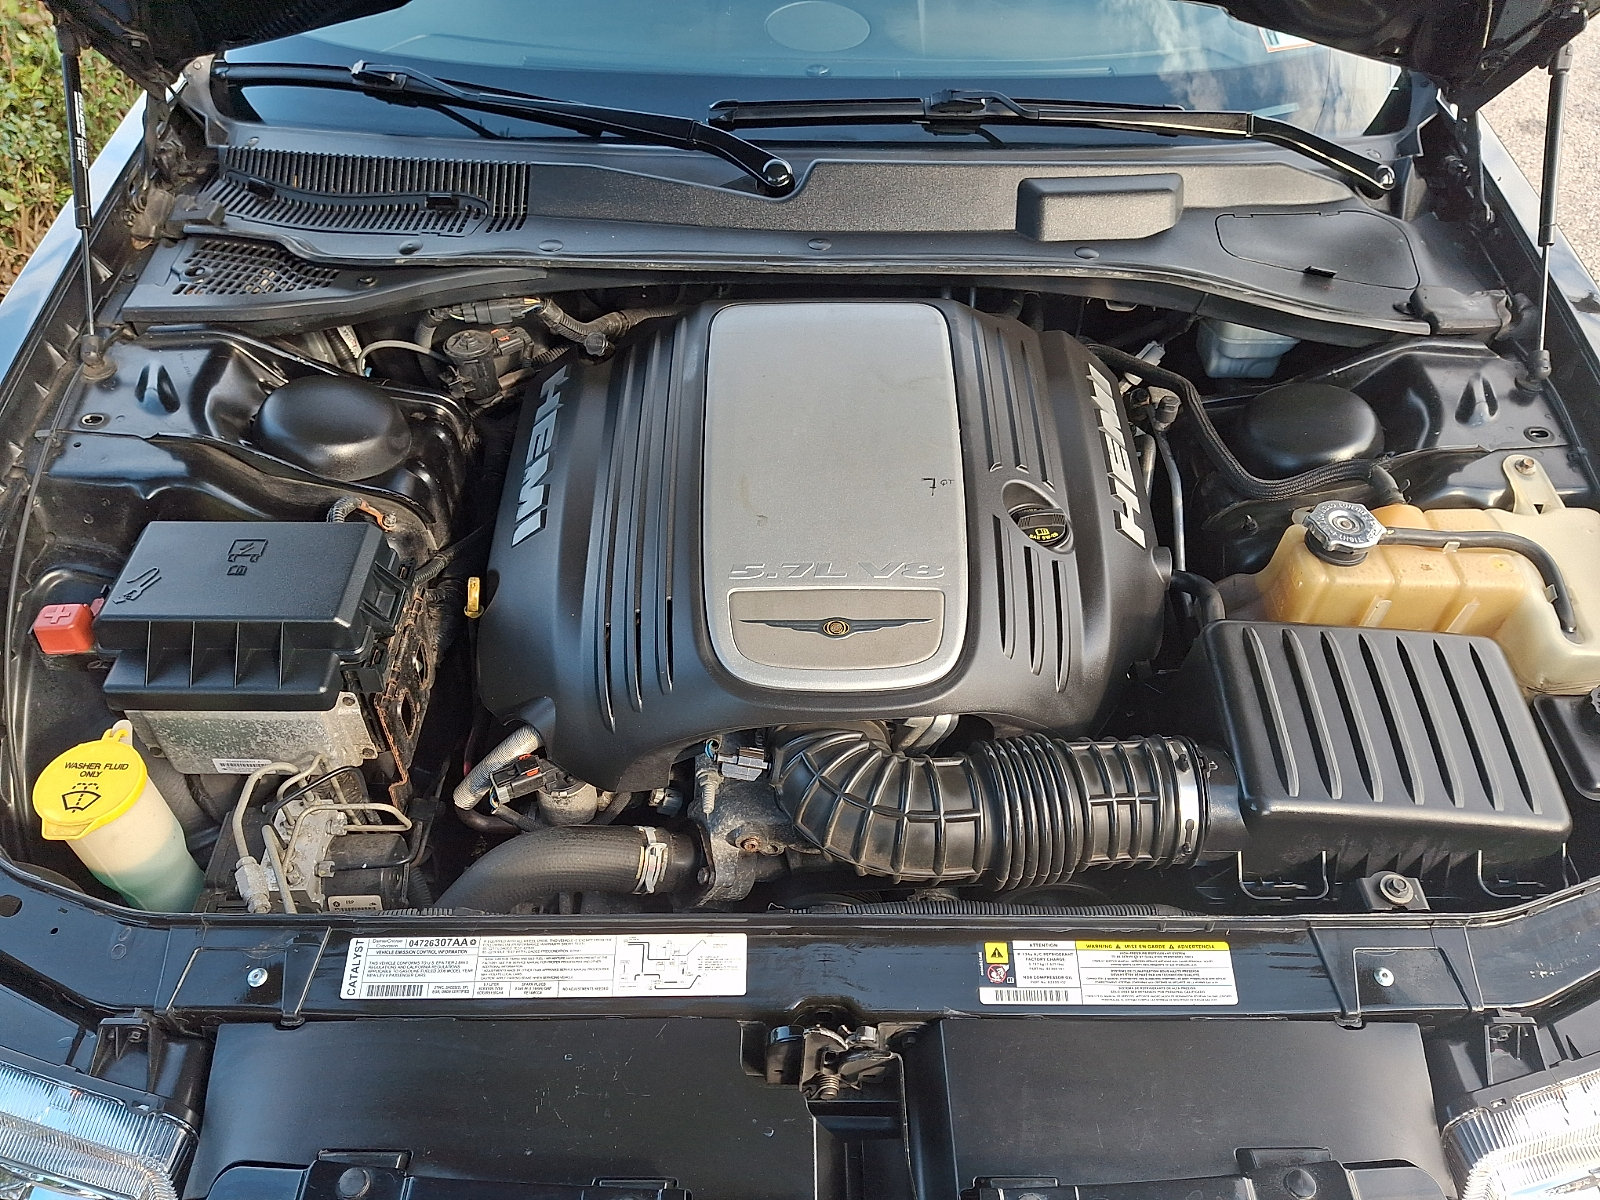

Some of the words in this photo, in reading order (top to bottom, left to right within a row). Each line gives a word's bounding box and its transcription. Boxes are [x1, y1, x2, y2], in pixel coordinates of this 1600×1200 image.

[511, 365, 569, 548] HEMI
[1086, 362, 1146, 550] HEMI
[728, 561, 848, 580] 5.7L
[858, 560, 945, 580] V8
[64, 762, 102, 770] WASHER
[408, 938, 468, 947] 04726307AA
[347, 939, 364, 996] CATALYST
